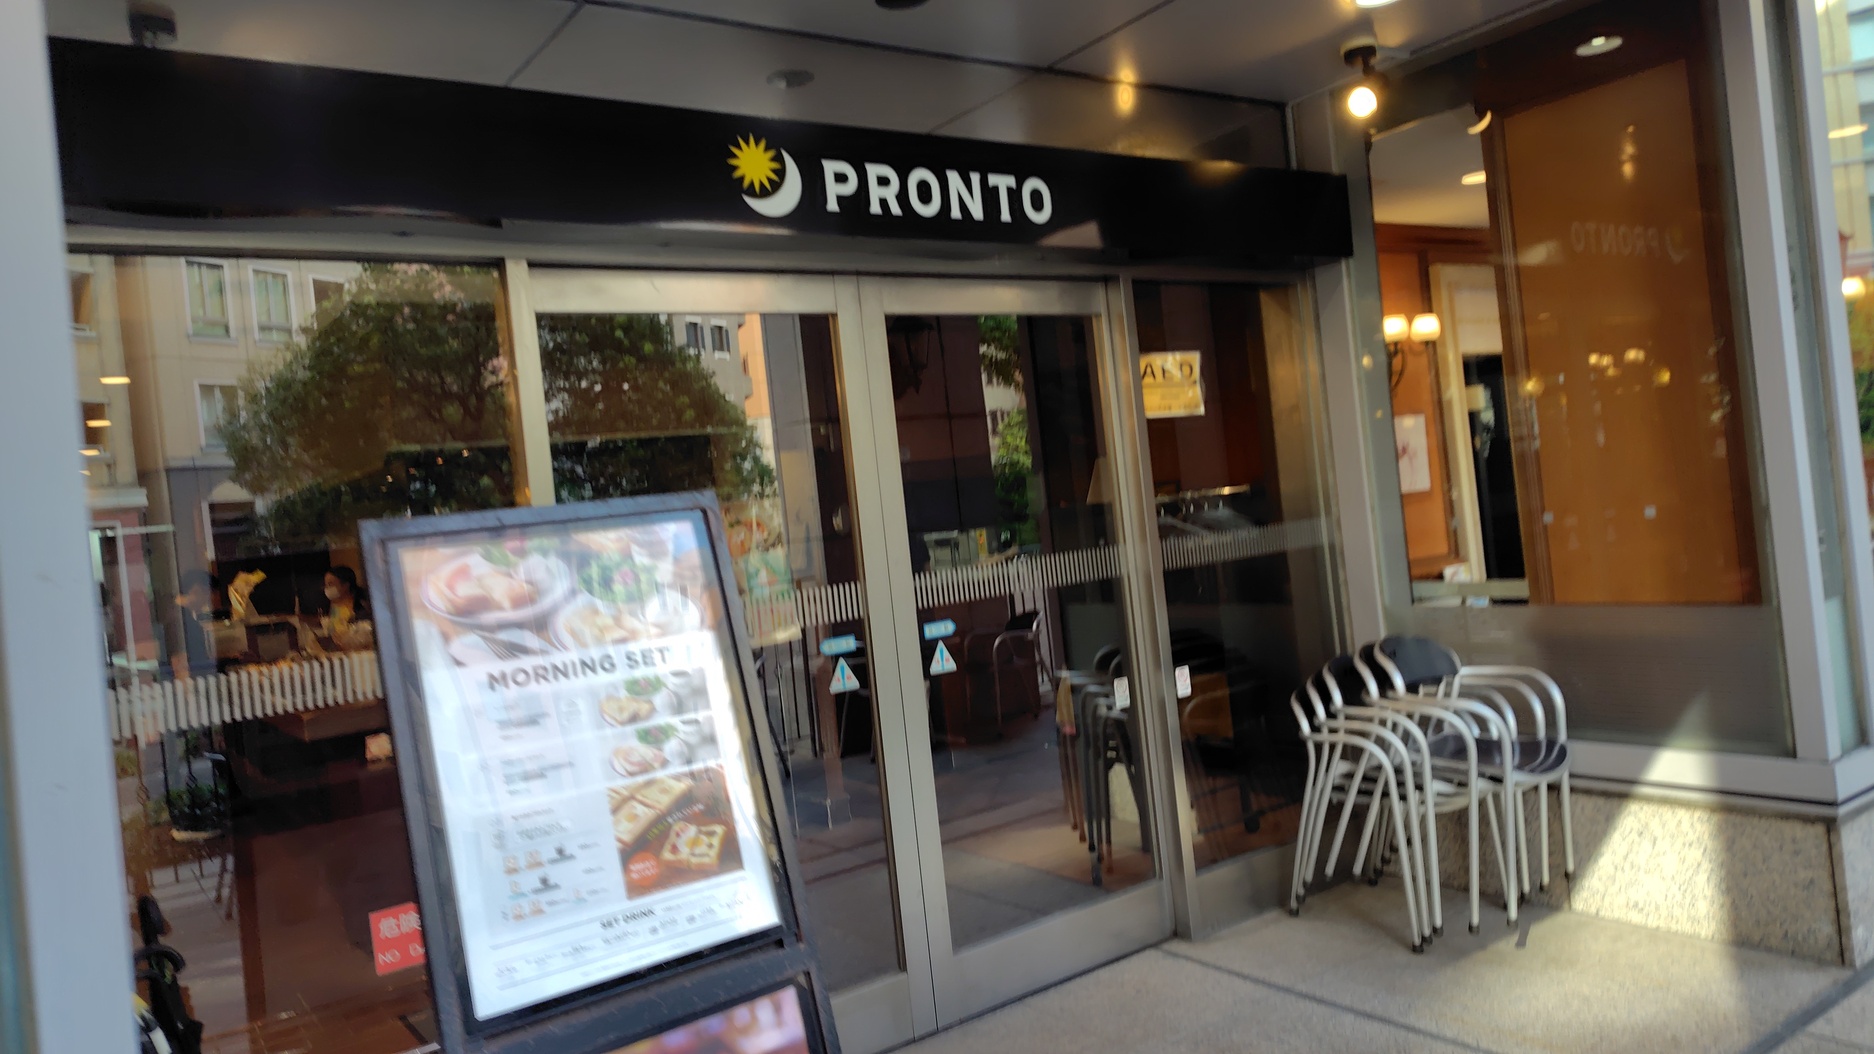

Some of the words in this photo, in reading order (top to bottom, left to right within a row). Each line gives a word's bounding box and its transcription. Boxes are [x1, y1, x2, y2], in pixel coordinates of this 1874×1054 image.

[820, 158, 1053, 226] PRONTO
[487, 652, 617, 692] MORNING
[625, 645, 670, 670] SET
[378, 948, 401, 966] NO
